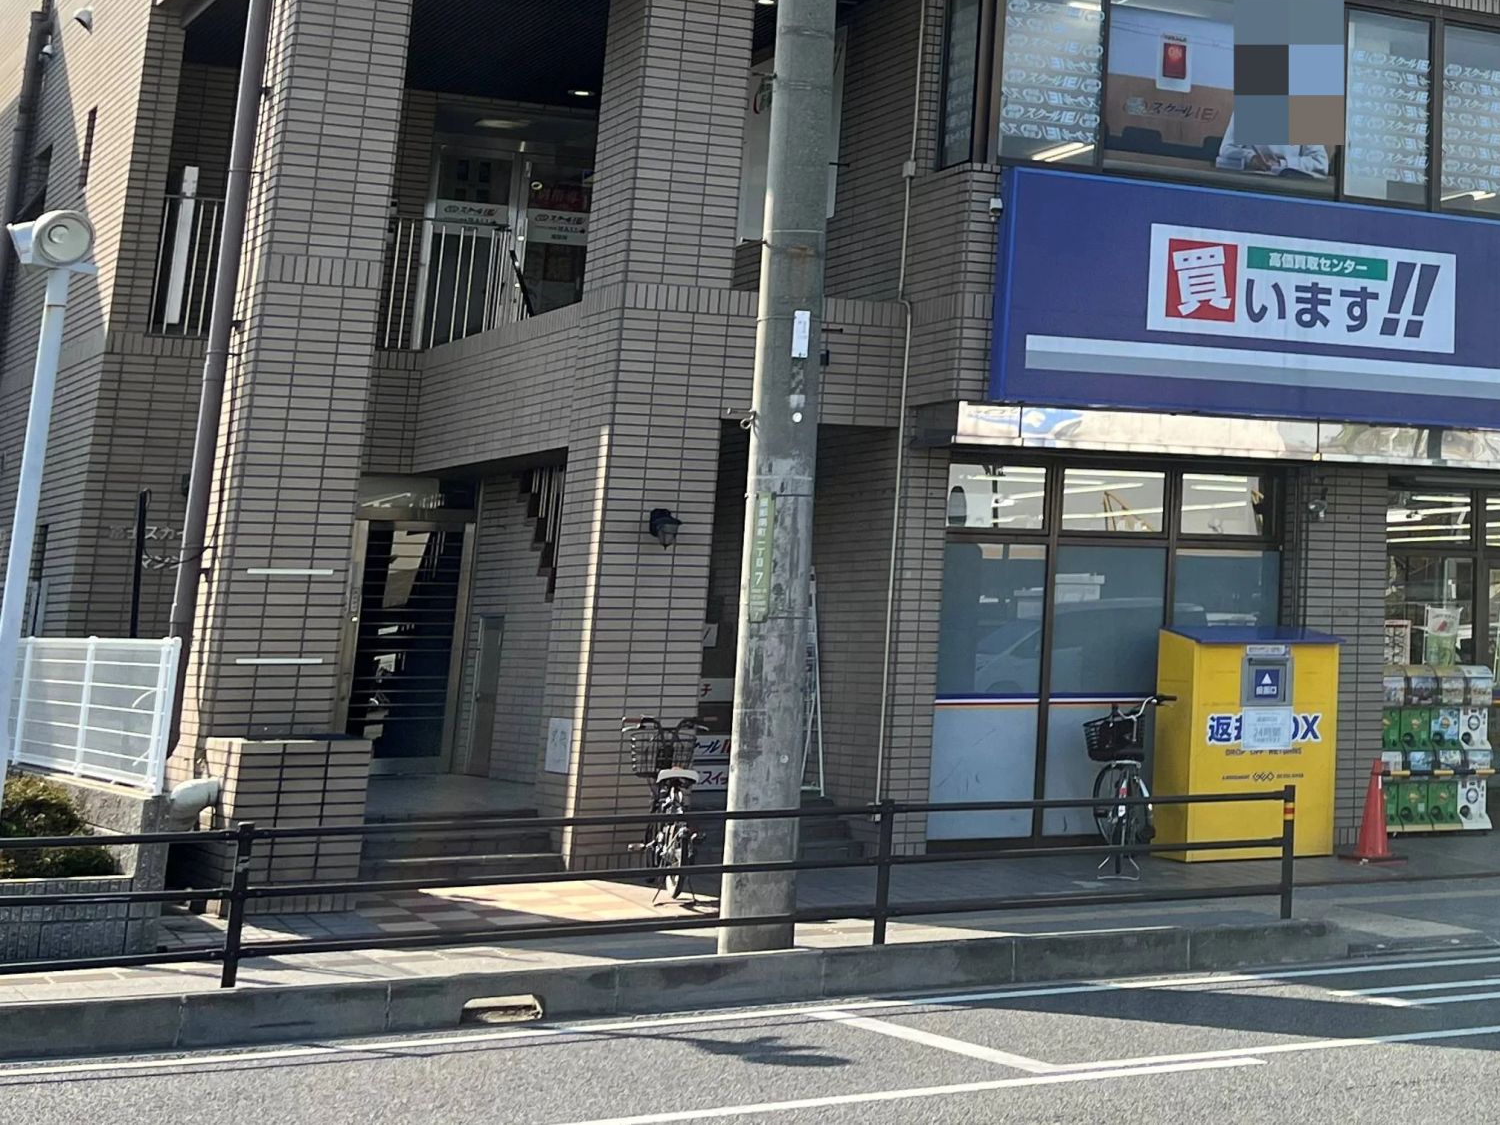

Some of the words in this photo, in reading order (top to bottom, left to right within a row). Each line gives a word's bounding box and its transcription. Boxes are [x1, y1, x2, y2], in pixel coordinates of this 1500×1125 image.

[1269, 252, 1368, 274] 高価買取センター
